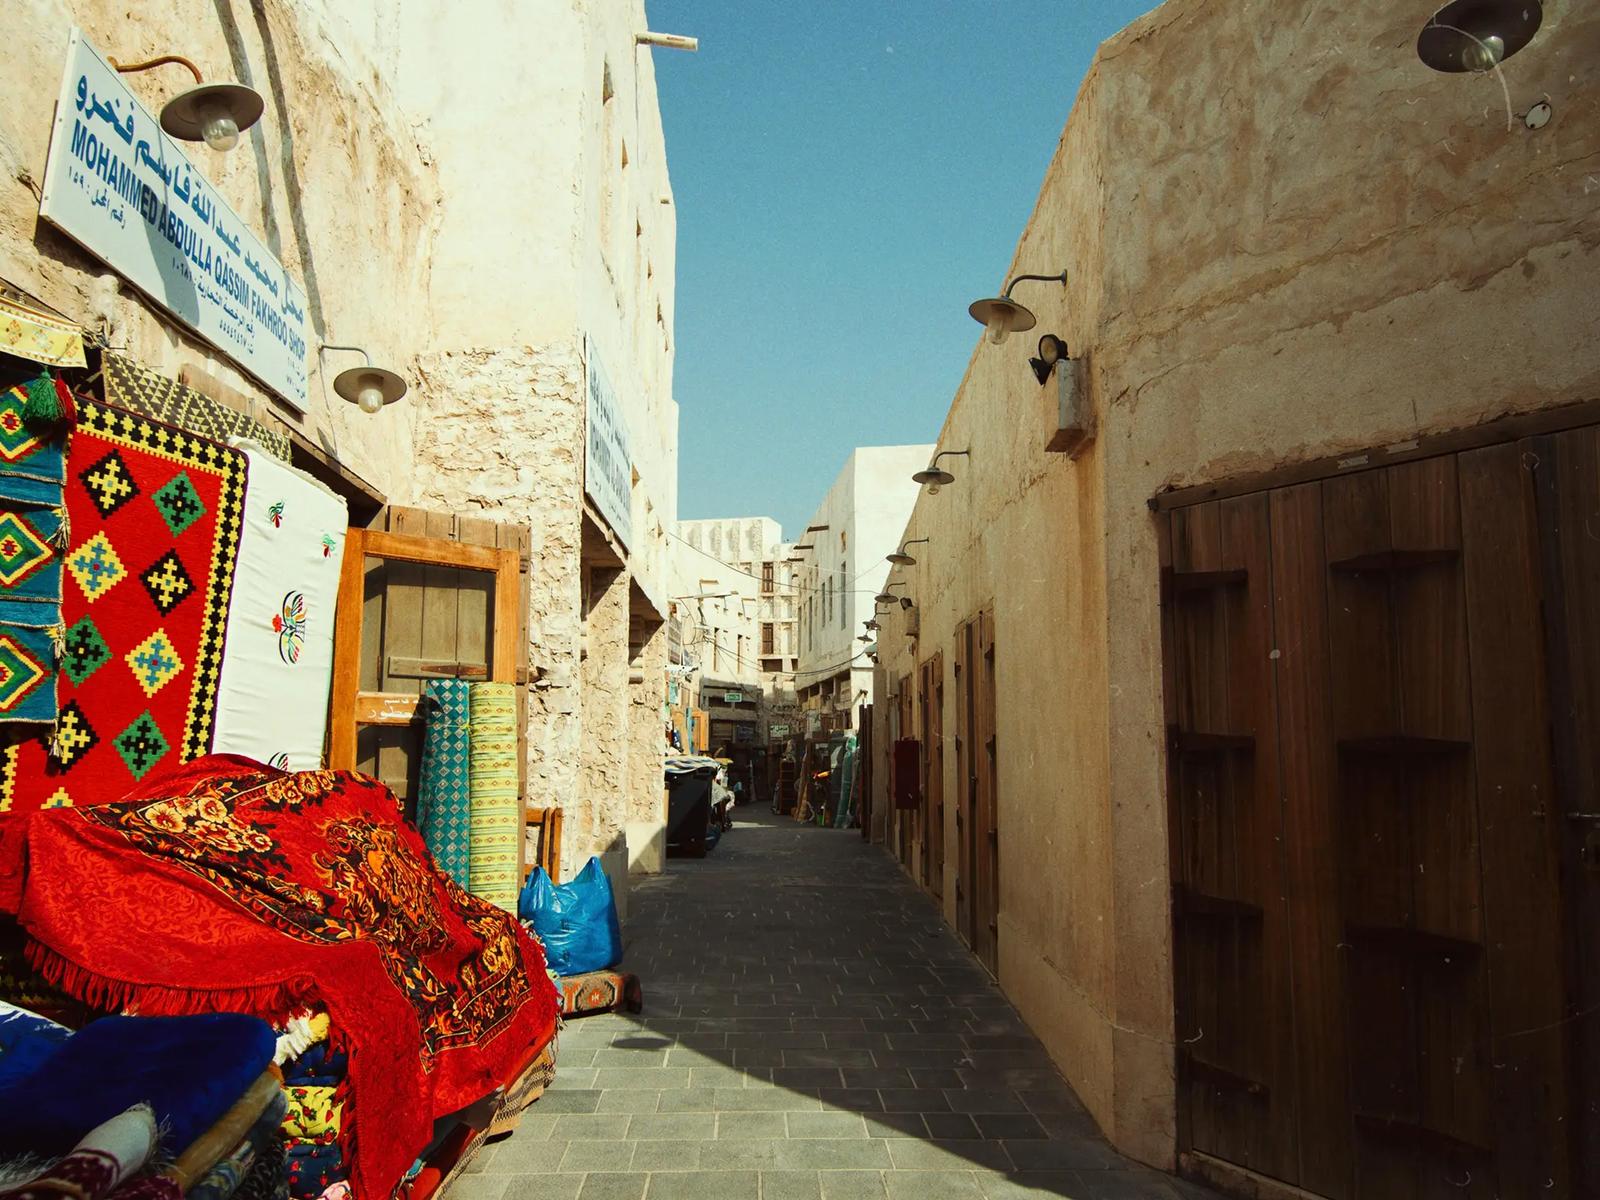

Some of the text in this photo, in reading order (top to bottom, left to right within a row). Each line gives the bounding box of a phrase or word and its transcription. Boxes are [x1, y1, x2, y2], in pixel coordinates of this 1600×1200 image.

[75, 75, 134, 147] فخرو
[68, 165, 85, 190] ١٥٩
[134, 139, 191, 205] قاسم
[70, 117, 305, 363] MOHAMMED ABDULLA QASSIM FAKHROO SHOP
[244, 250, 278, 299] محمد
[281, 285, 303, 325] محل
